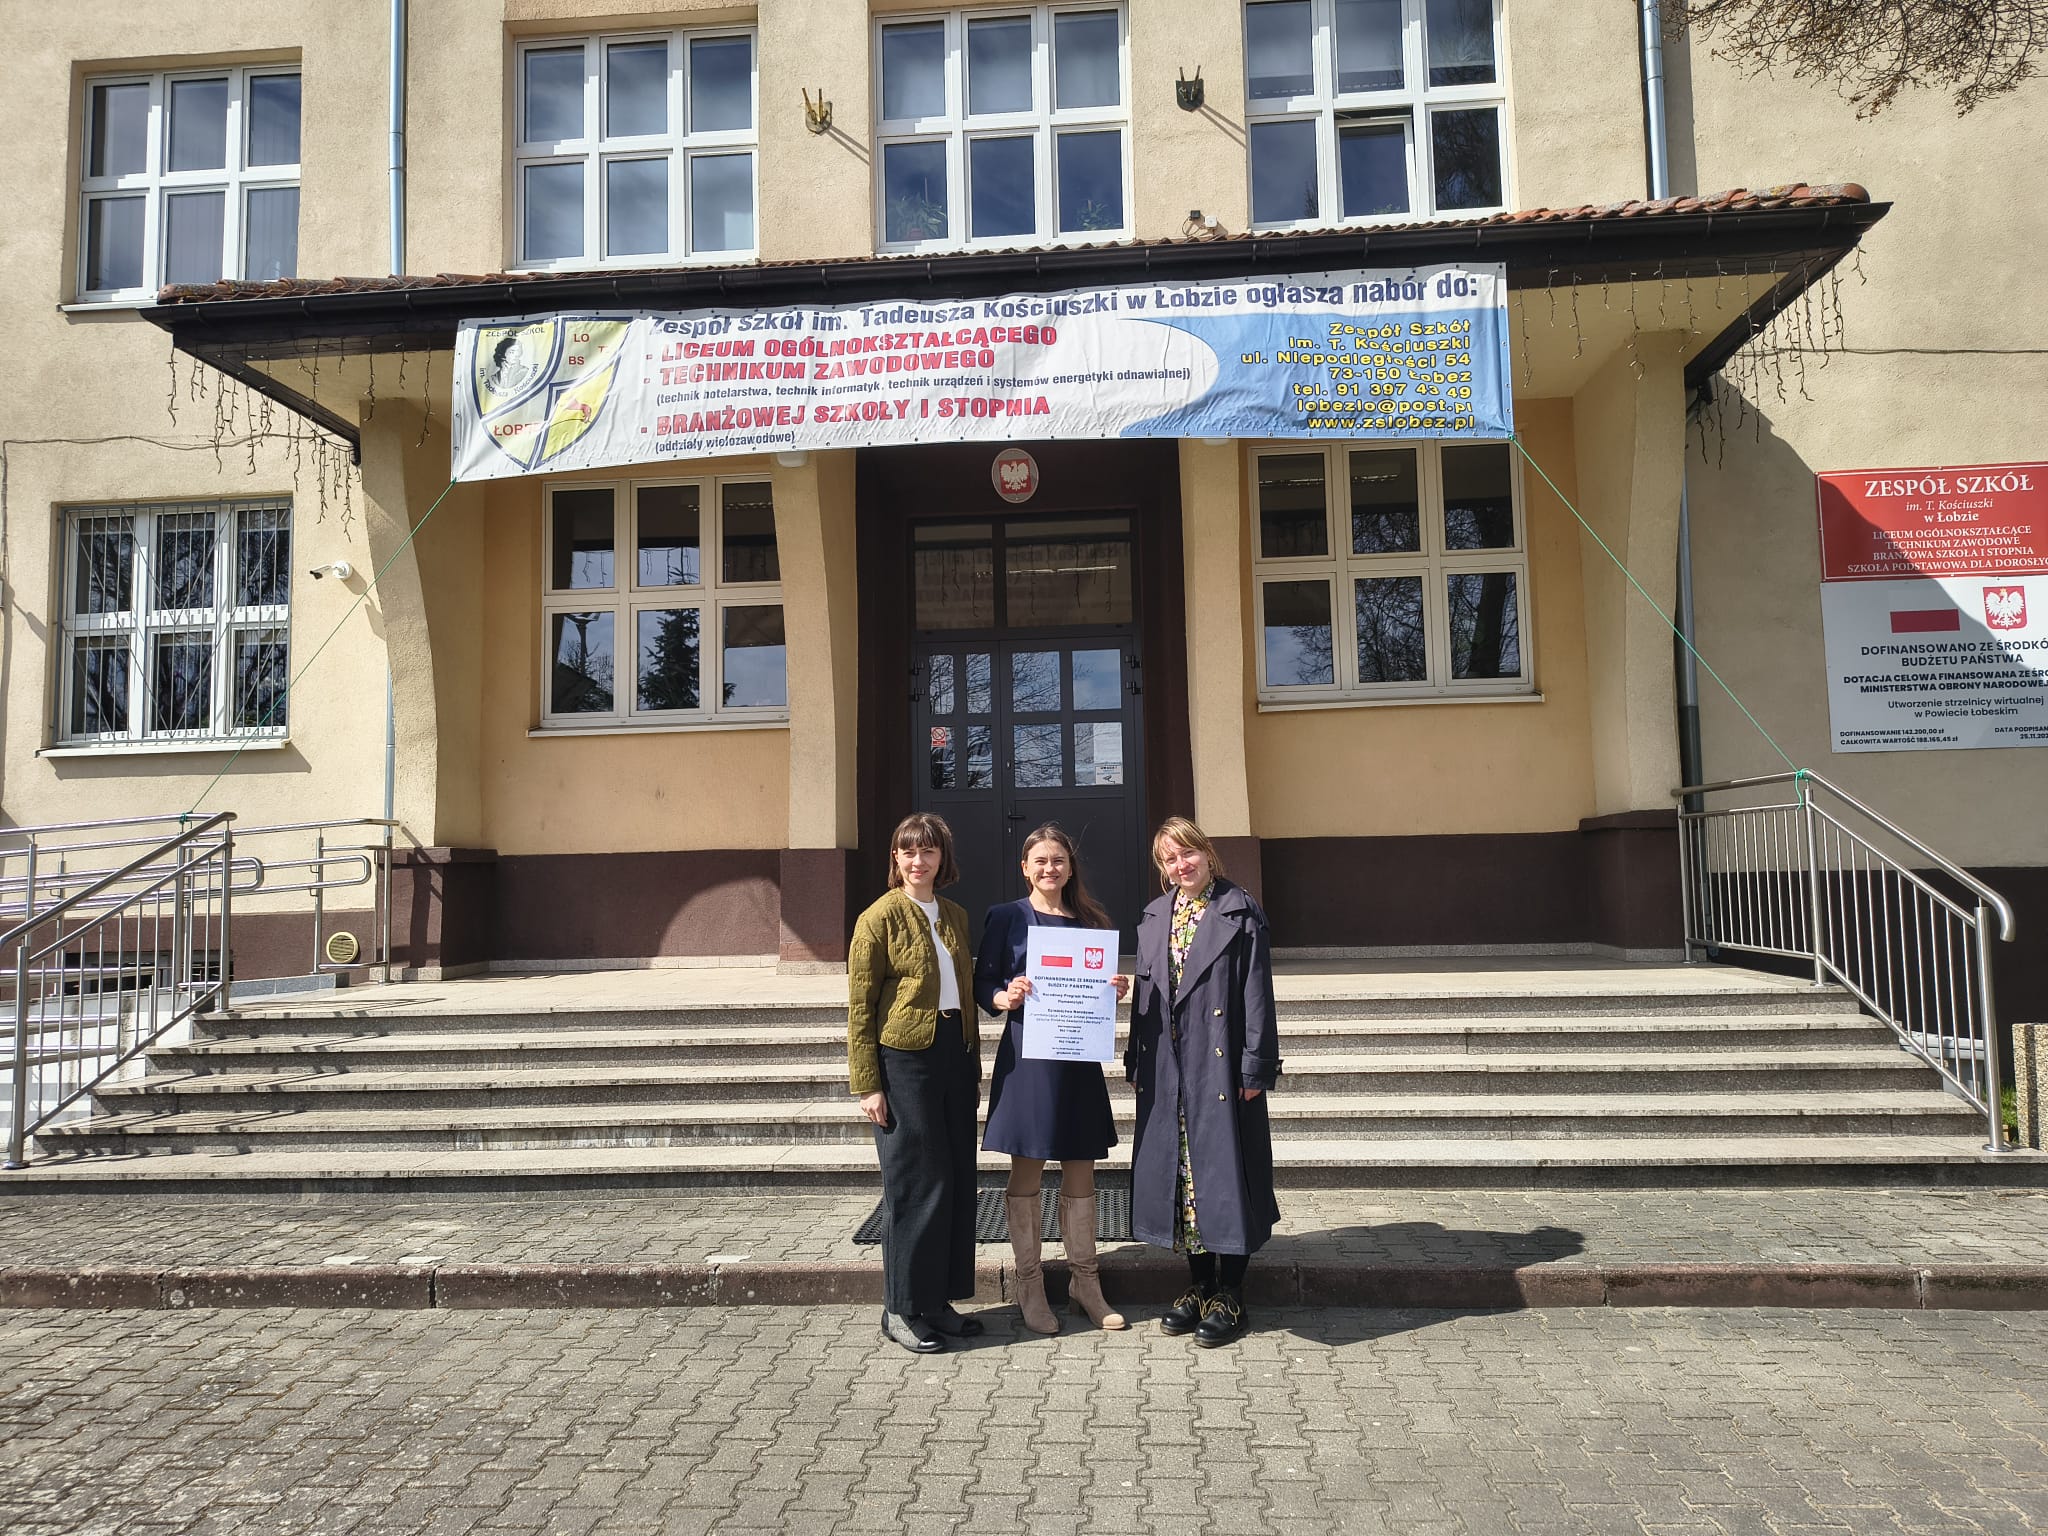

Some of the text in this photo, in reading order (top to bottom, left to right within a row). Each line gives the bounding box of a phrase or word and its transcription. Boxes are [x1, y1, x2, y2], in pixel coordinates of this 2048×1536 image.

[650, 273, 1478, 339] Zespół Szkół im. Tadeusza Kościuszki w Łobzie ogłasza nabór do:
[1329, 318, 1471, 339] Zespół Szkół
[573, 333, 590, 343] LO
[661, 324, 1058, 362] LICEUM OGÓLNOKSZTAŁCĄCEGO
[1328, 338, 1346, 351] T.
[1355, 335, 1471, 354] Kościuszki
[568, 356, 585, 366] BS
[659, 349, 995, 386] TECHNIKUM ZAWODOWEGO
[1241, 351, 1471, 369] ul. Niepodległości 54
[1329, 366, 1472, 384] 73-150 Łobez
[656, 387, 700, 407] (technik
[776, 385, 818, 397] technik
[888, 375, 930, 390] technik
[934, 374, 984, 391] urządzeń
[986, 375, 991, 386] i
[993, 376, 1049, 389] systemów
[1052, 370, 1114, 385] energetyki
[1117, 367, 1191, 381] odnawialnej)
[1293, 382, 1472, 400] tel. 91 397 43 49
[1297, 399, 1474, 415] lobezlo@post.pl
[656, 395, 1051, 437] BRANŻOWEJ SZKOŁY I STOPNIA
[1307, 414, 1475, 431] www.zslobez.pl
[1864, 471, 2034, 498] ZESPÓŁ SZKÓŁ
[1905, 498, 1994, 511] im. T. Kościuszki
[1923, 510, 1980, 523] w Łobzie
[1872, 525, 2032, 540] LICEUM OGÓLNOKSZTAŁCĄCE
[1885, 536, 2020, 550] TECHNIKUM ZAWODOWE
[1873, 546, 2034, 561] BRANŻOWA SZKOŁA I STOPNIA
[1847, 563, 1890, 573] SZKOŁA
[1892, 560, 1968, 571] PODSTAWOWA
[1970, 559, 1992, 569] DLA
[1861, 642, 1977, 656] DOFINANSOWANO
[1979, 641, 1994, 652] ZE
[1901, 652, 2024, 667] BUDŻETU PAŃSTWA
[1843, 674, 1893, 684] DOTACJA
[1893, 673, 1938, 682] CELOWA
[1938, 670, 2017, 681] FINANSOWANA
[2018, 670, 2031, 678] ZE
[1860, 681, 1938, 693] MINISTERSTWA
[1938, 680, 1982, 691] OBRONY
[1888, 695, 2045, 709] Utworzenie strzelnicy wirtualnej
[1914, 706, 2019, 719] w Powiecie Łobeskim
[1840, 737, 1882, 745] CAŁKOWITA
[1882, 735, 1916, 744] WARTOŚĆ
